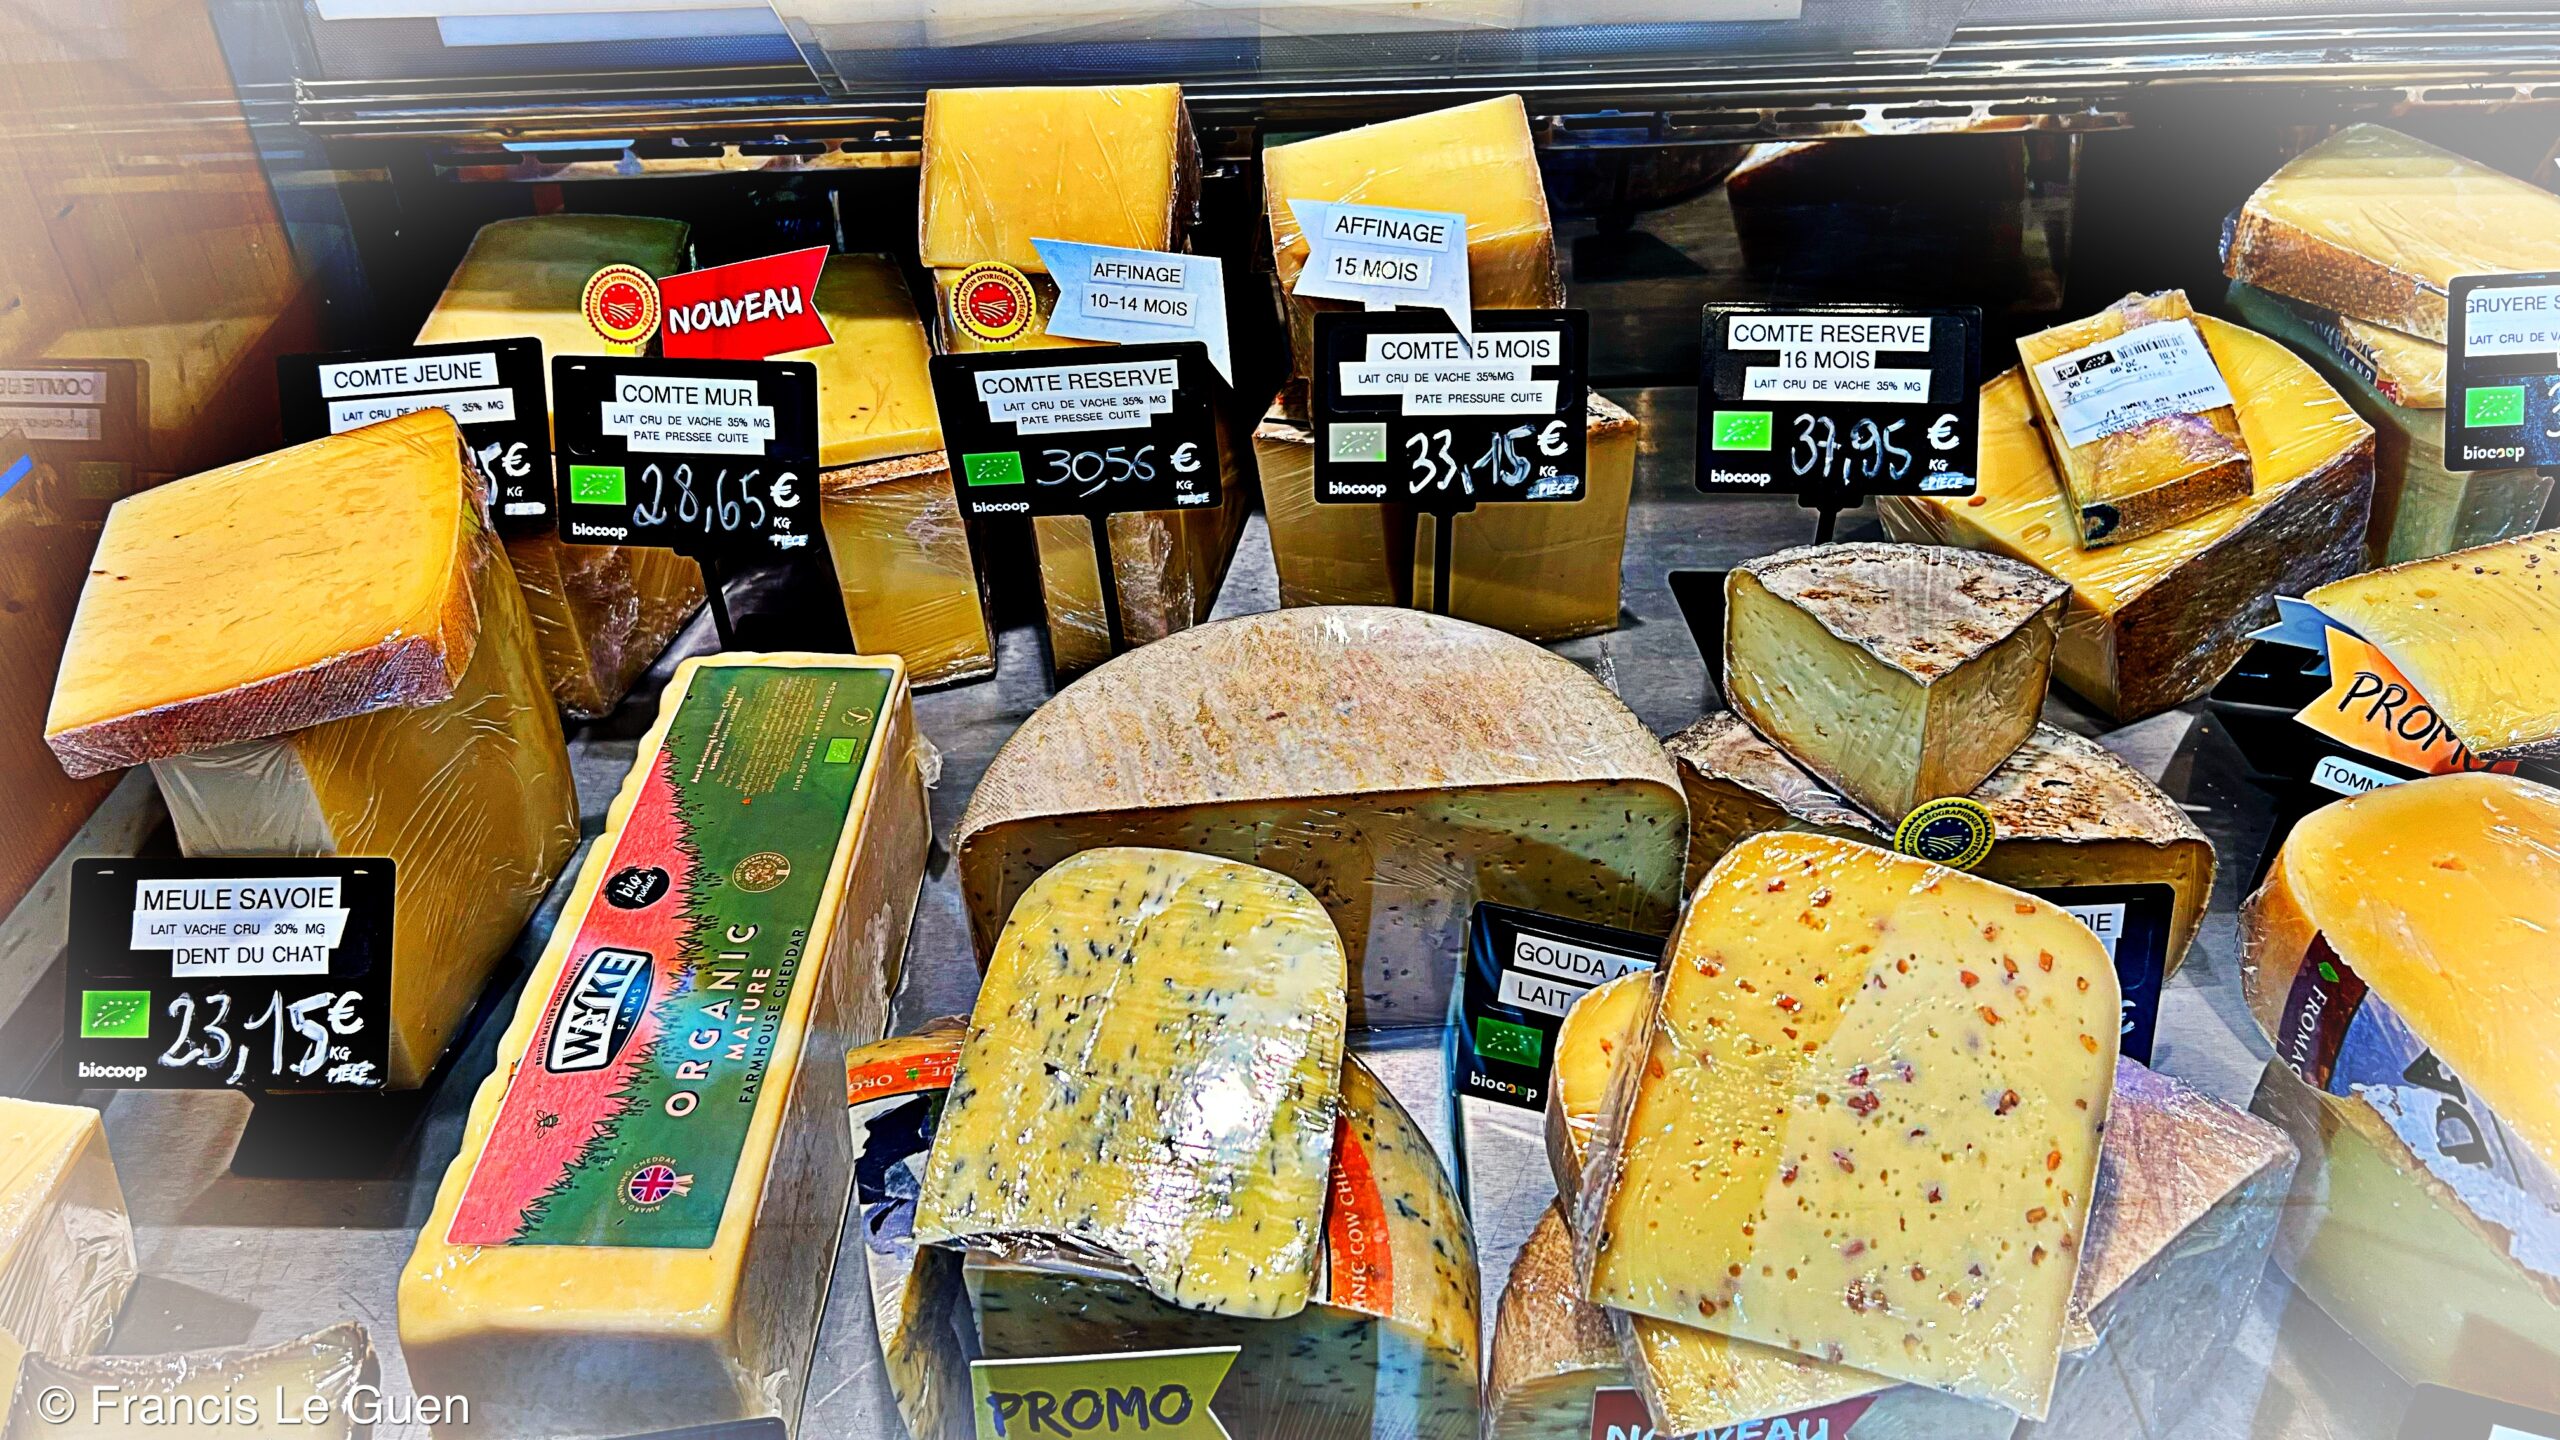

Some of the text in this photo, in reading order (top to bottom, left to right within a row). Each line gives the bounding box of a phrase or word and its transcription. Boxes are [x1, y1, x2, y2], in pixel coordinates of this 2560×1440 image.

[1335, 215, 1445, 244] AFFINAGE
[1093, 262, 1181, 283] AFFINAGE
[1335, 256, 1418, 281] 15 MOIS
[960, 278, 977, 322] APPELLATION
[977, 273, 1014, 287] D'ORIGINE
[1090, 294, 1188, 316] 10-14 MOIS
[2466, 296, 2547, 314] GRUYERE
[669, 286, 803, 334] NOUVEAU
[1734, 323, 1925, 344] COMTE RESERVE
[2469, 334, 2493, 345] LAIT
[2499, 333, 2523, 344] CRU
[2530, 332, 2545, 342] DE
[1381, 340, 1458, 360] COMTE
[1495, 339, 1550, 358] MOIS
[1784, 351, 1870, 369] 16 MOIS
[334, 362, 482, 389] COMTE JEUNE
[982, 367, 1173, 395] COMTE RESERVE
[1358, 374, 1380, 384] LAIT
[1386, 373, 1409, 383] CRU
[1415, 373, 1429, 383] DE
[1435, 372, 1471, 382] VACHE
[1754, 379, 1921, 392] LAIT CRU DE VACHE 35% MG
[622, 384, 752, 407] COMTE MUR
[1003, 395, 1166, 412] LAIT CRU DE VACHE 35% MG
[1415, 392, 1542, 404] PATE PRESSURE CUITE
[342, 410, 364, 422] LAIT
[369, 408, 391, 420] CRU
[462, 401, 483, 412] 35%
[488, 400, 504, 410] MG
[613, 414, 770, 429] LAIT CRU DE VACHE 35% MG
[1021, 410, 1141, 425] PATE PRESSEE CUITE
[634, 430, 749, 443] PATE PRESSEE CUITE
[502, 442, 531, 477] €
[1170, 442, 1201, 473] €
[1405, 420, 1568, 495] 33,15 €
[1791, 413, 1960, 486] 37,95 €
[2463, 445, 2525, 463] biocoop
[1539, 466, 1559, 478] KG
[1929, 458, 1949, 471] KG
[1176, 480, 1194, 490] KG
[1711, 469, 1771, 487] biocoop
[507, 486, 524, 498] KG
[633, 463, 801, 533] 28,65 €
[1329, 482, 1387, 498] biocoop
[972, 501, 1030, 515] biocoop
[572, 523, 628, 540] biocoop
[774, 516, 791, 529] KG
[143, 887, 334, 911] MEULE SAVOIE
[151, 923, 325, 936] LAIT VACHE CRU 30% MG
[176, 945, 326, 965] DENT DU CHAT
[1517, 942, 1607, 979] GOUDA
[1518, 981, 1571, 1010] LAIT
[536, 954, 588, 1066] BRITISH MASTER CHEESEMAKERS
[562, 955, 638, 1066] WYKE
[617, 988, 642, 1030] FARMS
[724, 967, 772, 1060] MATURE
[739, 929, 805, 1104] FARMHOUSE CHEDDAR
[664, 923, 759, 1118] ORGANIC
[158, 990, 364, 1085] 23,15 €
[328, 1046, 352, 1061] KG
[78, 1062, 147, 1081] biocoop
[1470, 1071, 1538, 1102] biocoop
[633, 1155, 677, 1170] CHEDDAR
[1345, 1210, 1365, 1256] COW
[986, 1383, 1194, 1438] PROMO
